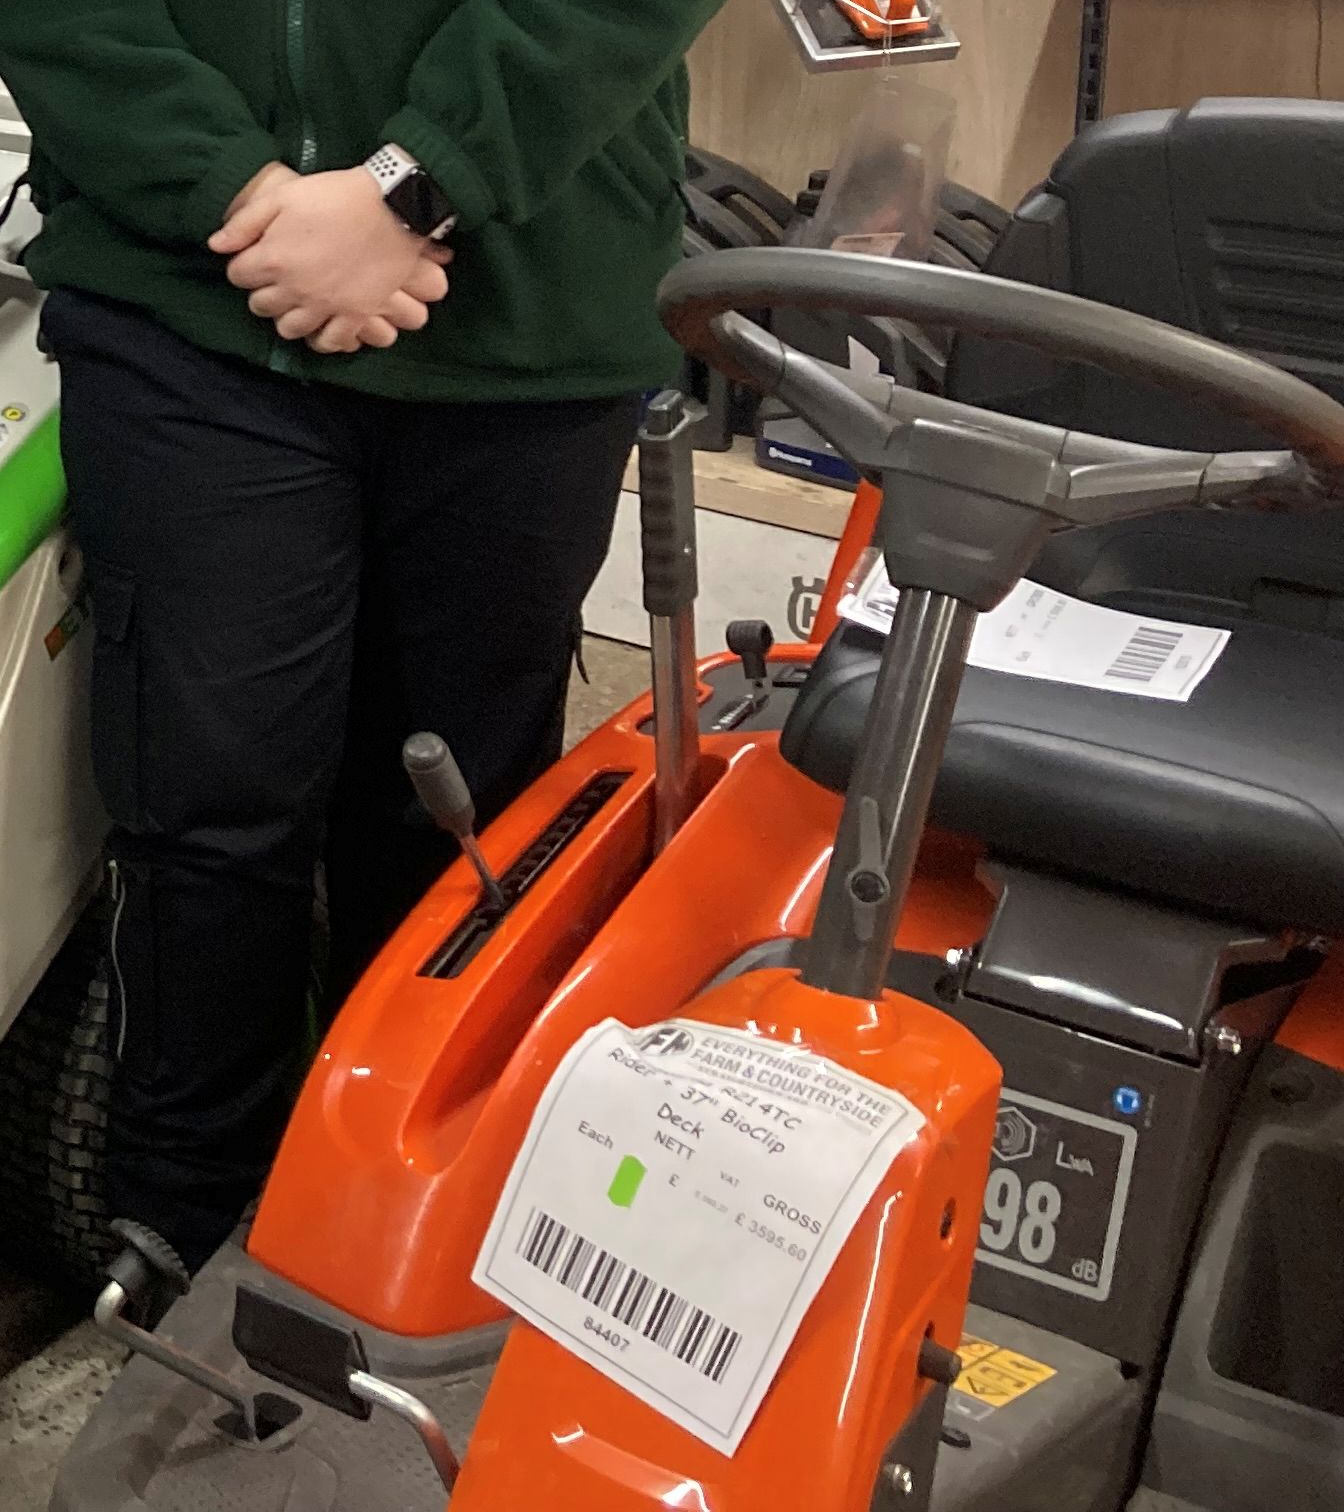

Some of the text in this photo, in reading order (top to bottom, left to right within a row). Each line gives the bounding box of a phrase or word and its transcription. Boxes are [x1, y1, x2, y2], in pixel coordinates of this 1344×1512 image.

[690, 1049, 742, 1078] FARM
[756, 1067, 882, 1128] COUNTRYSIDE
[700, 1038, 812, 1079] EVERYTHING
[813, 1073, 855, 1098] FOR
[857, 1089, 893, 1116] THE
[657, 1102, 705, 1139] Deck
[720, 1108, 786, 1155] BioClip
[577, 1120, 615, 1151] Each
[654, 1130, 696, 1161] NETT
[762, 1193, 823, 1235] GROSS
[979, 1167, 1061, 1264] 98
[748, 1219, 808, 1263] 3595.60
[1071, 1258, 1098, 1282] dB
[583, 1315, 631, 1352] 84407
